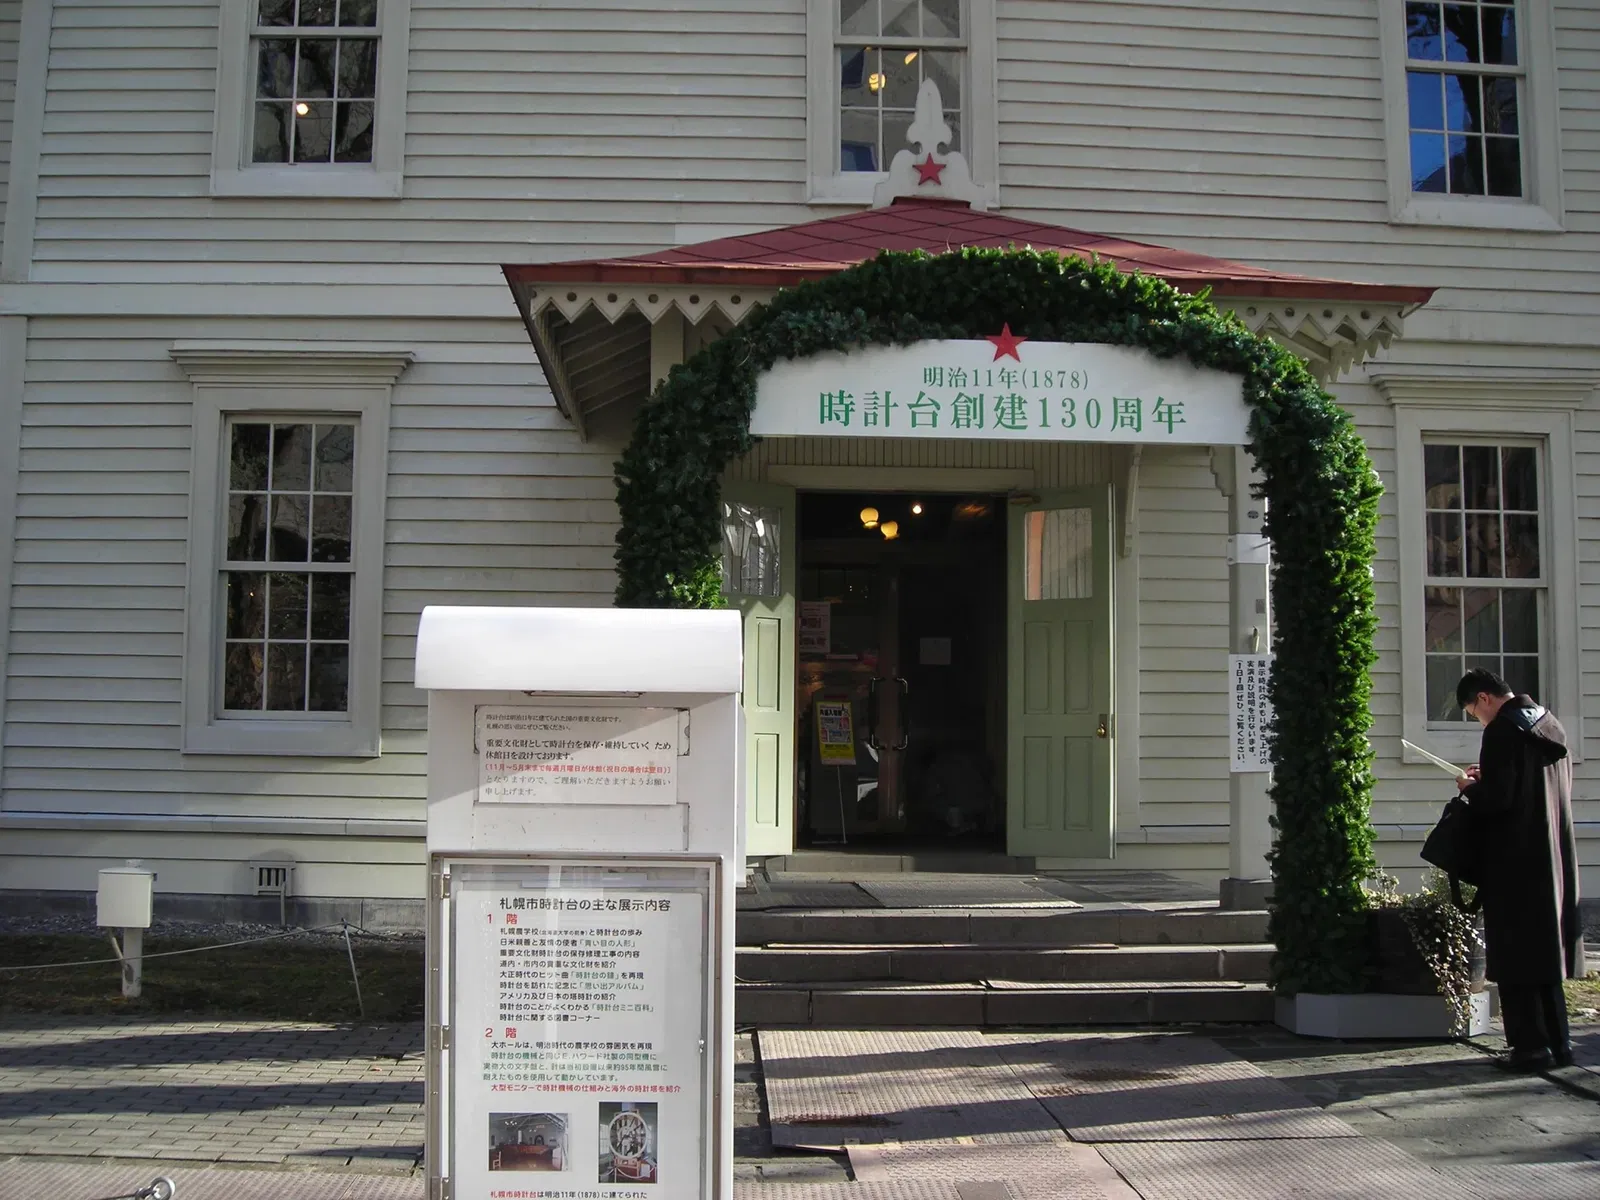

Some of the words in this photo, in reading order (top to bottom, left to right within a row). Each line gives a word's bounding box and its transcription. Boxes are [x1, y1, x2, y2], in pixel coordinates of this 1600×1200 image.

[923, 366, 1089, 390] 明治11年(1878)
[818, 390, 1188, 434] 時計台創建130周年
[486, 751, 575, 761] 休館日を設けております。
[485, 787, 537, 796] 申し上げます。
[500, 897, 671, 911] 札幌市時計台の主な展示内容
[500, 949, 641, 958] 重要文化財時計台の保存修理工事の内容
[500, 960, 617, 969] 道内・市内の貴重な文化財を紹介
[500, 992, 617, 1001] アメリカ及び日本の塔時計の紹介
[500, 1014, 601, 1022] 時計台に関する図書コーナー
